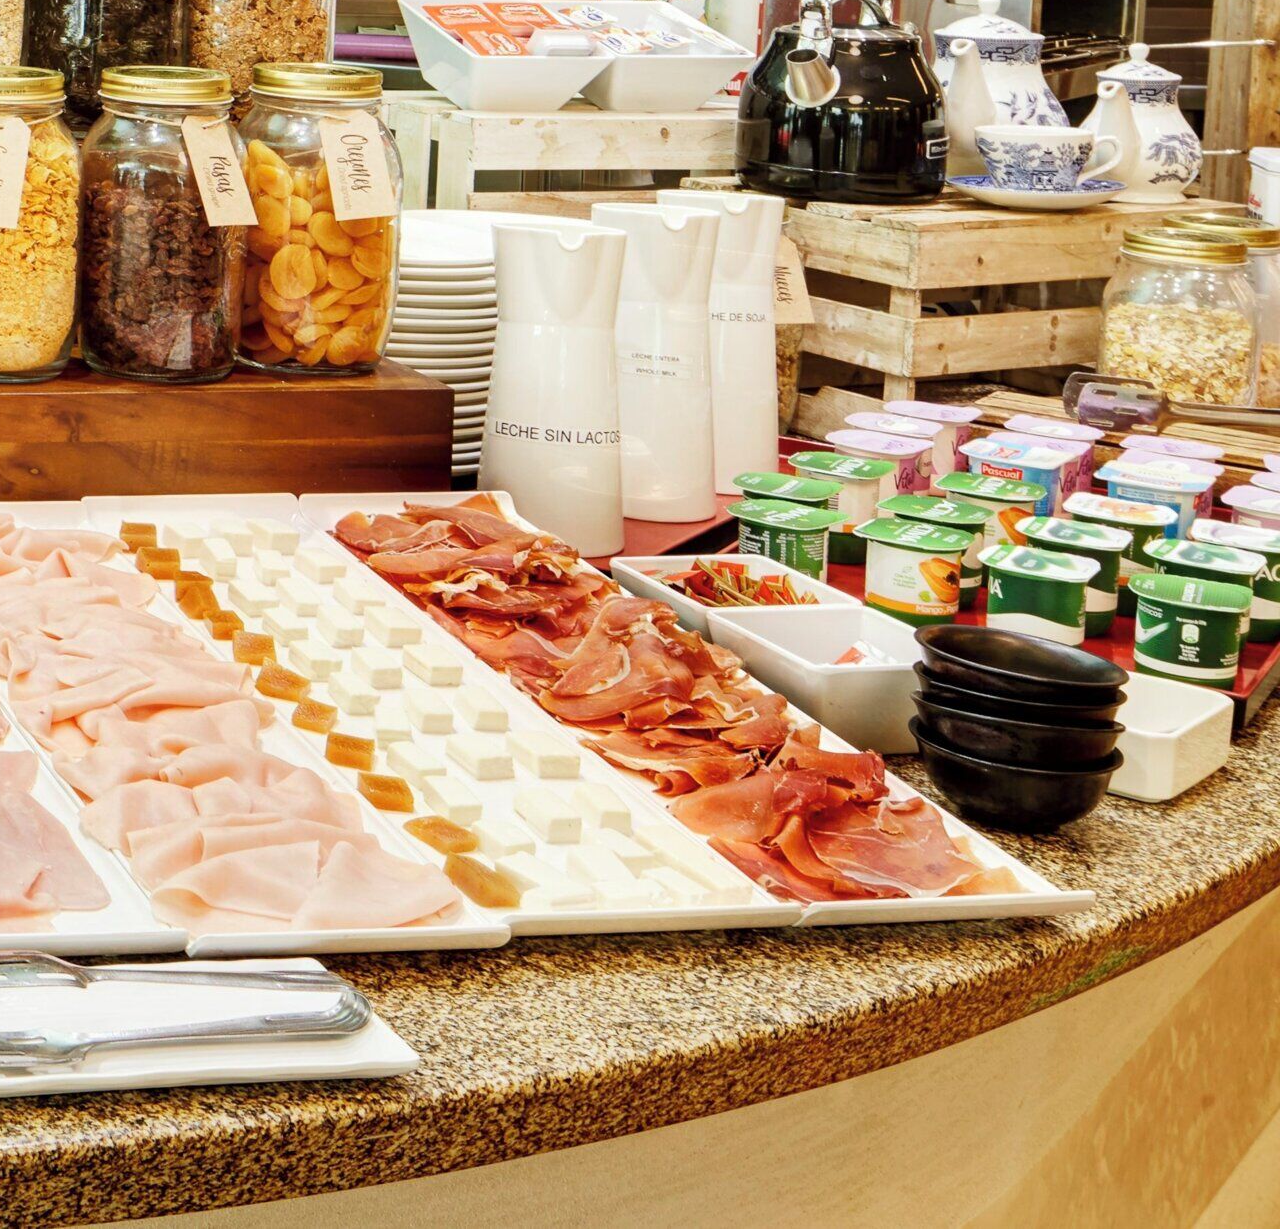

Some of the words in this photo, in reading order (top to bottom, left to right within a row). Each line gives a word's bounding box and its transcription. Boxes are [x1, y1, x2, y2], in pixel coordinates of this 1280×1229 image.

[337, 134, 372, 194] Orejones
[209, 156, 235, 198] Pasas
[729, 312, 743, 321] DE
[495, 421, 539, 440] LECHE
[544, 428, 572, 443] SIN
[982, 465, 1021, 481] Pascual
